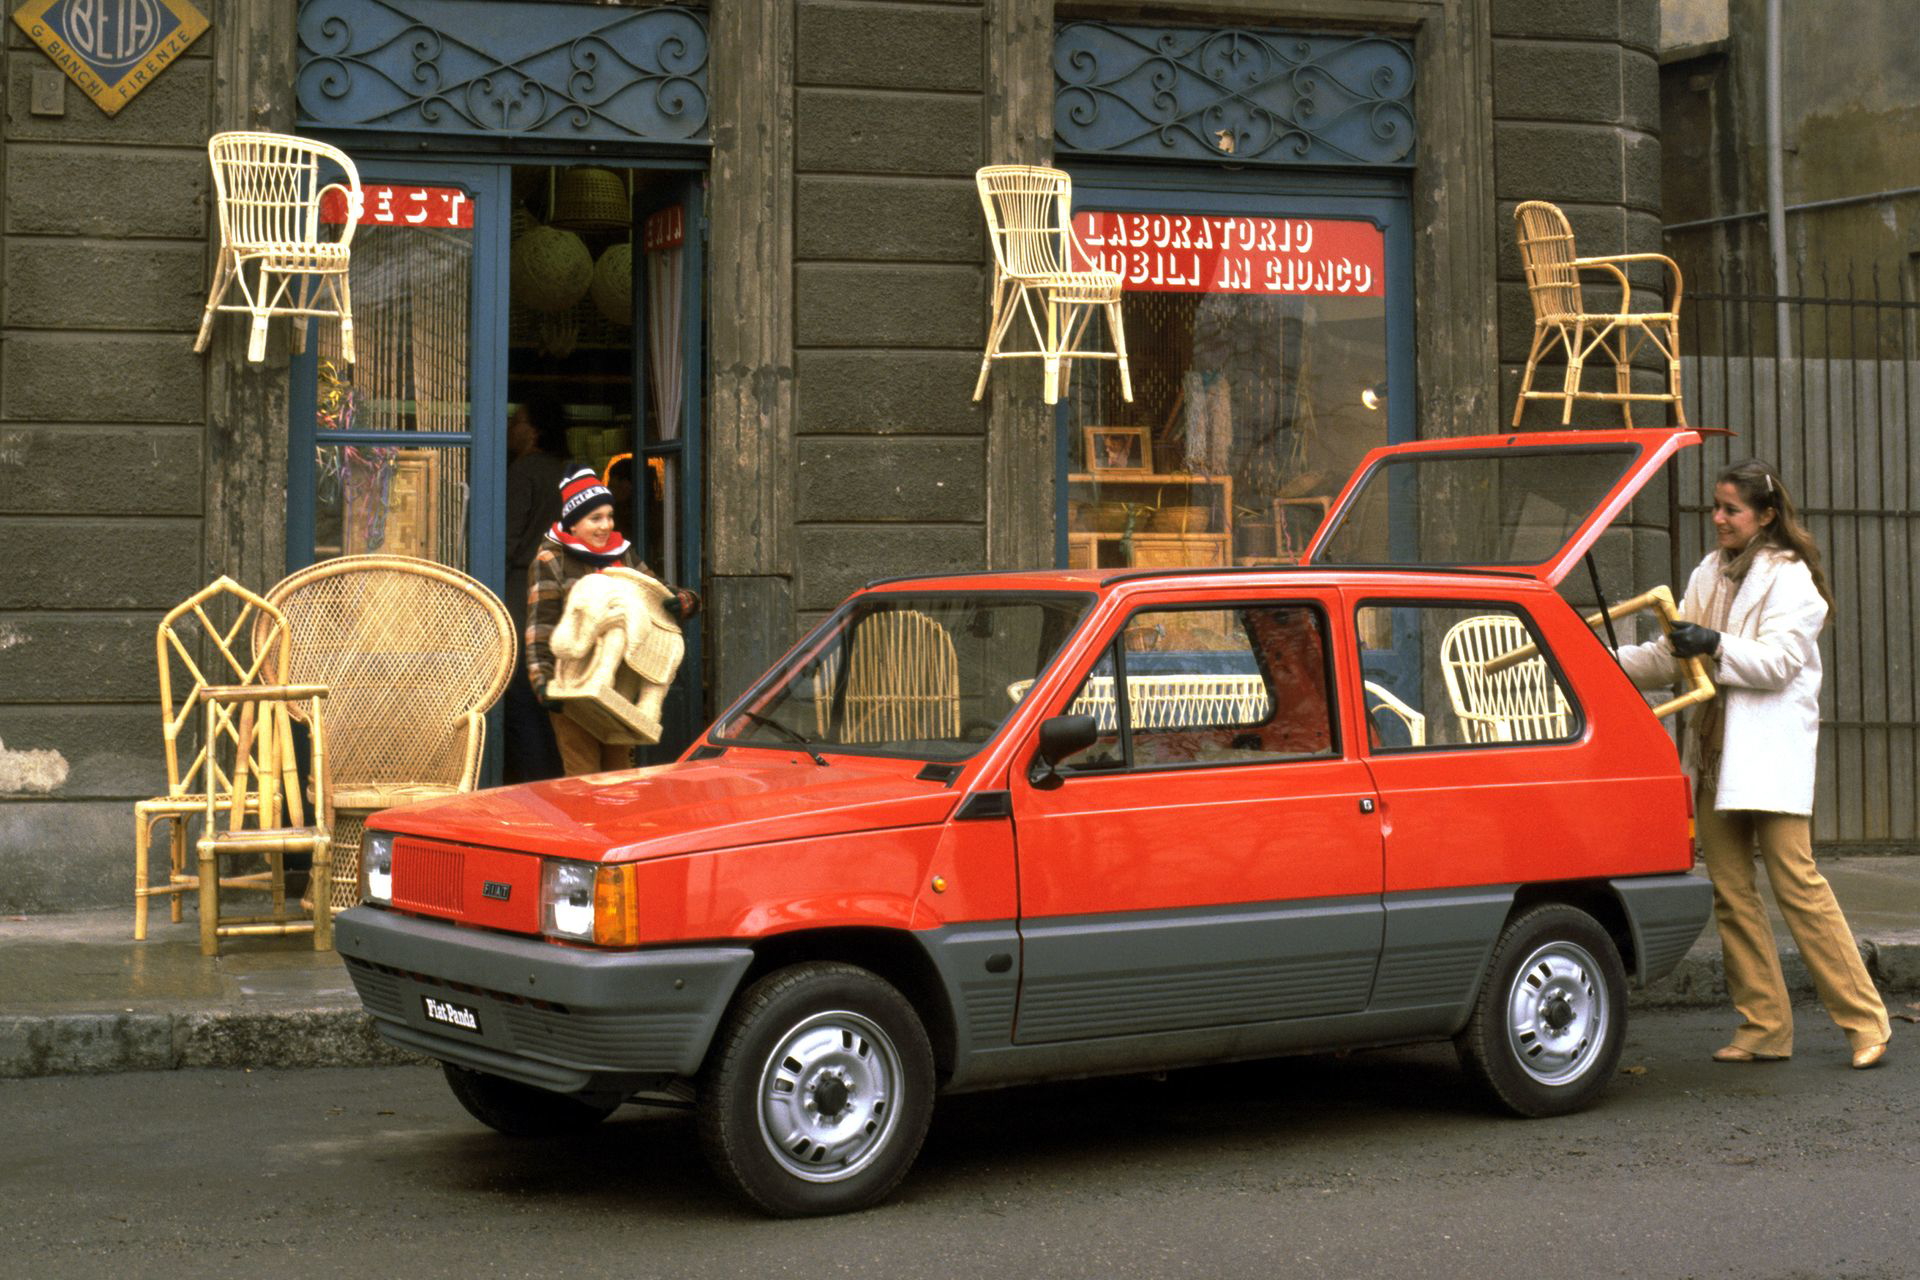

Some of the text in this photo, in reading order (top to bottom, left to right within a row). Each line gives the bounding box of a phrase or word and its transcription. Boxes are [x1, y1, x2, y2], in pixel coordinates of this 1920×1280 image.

[31, 24, 103, 97] G. BIANCHI
[119, 31, 191, 98] FIRENZE
[1084, 213, 1313, 253] LABORATORIO
[1217, 256, 1251, 289] IN
[1264, 256, 1372, 293] GIUNCO
[484, 882, 510, 898] FIAT
[425, 998, 477, 1029] Fiat Panda
